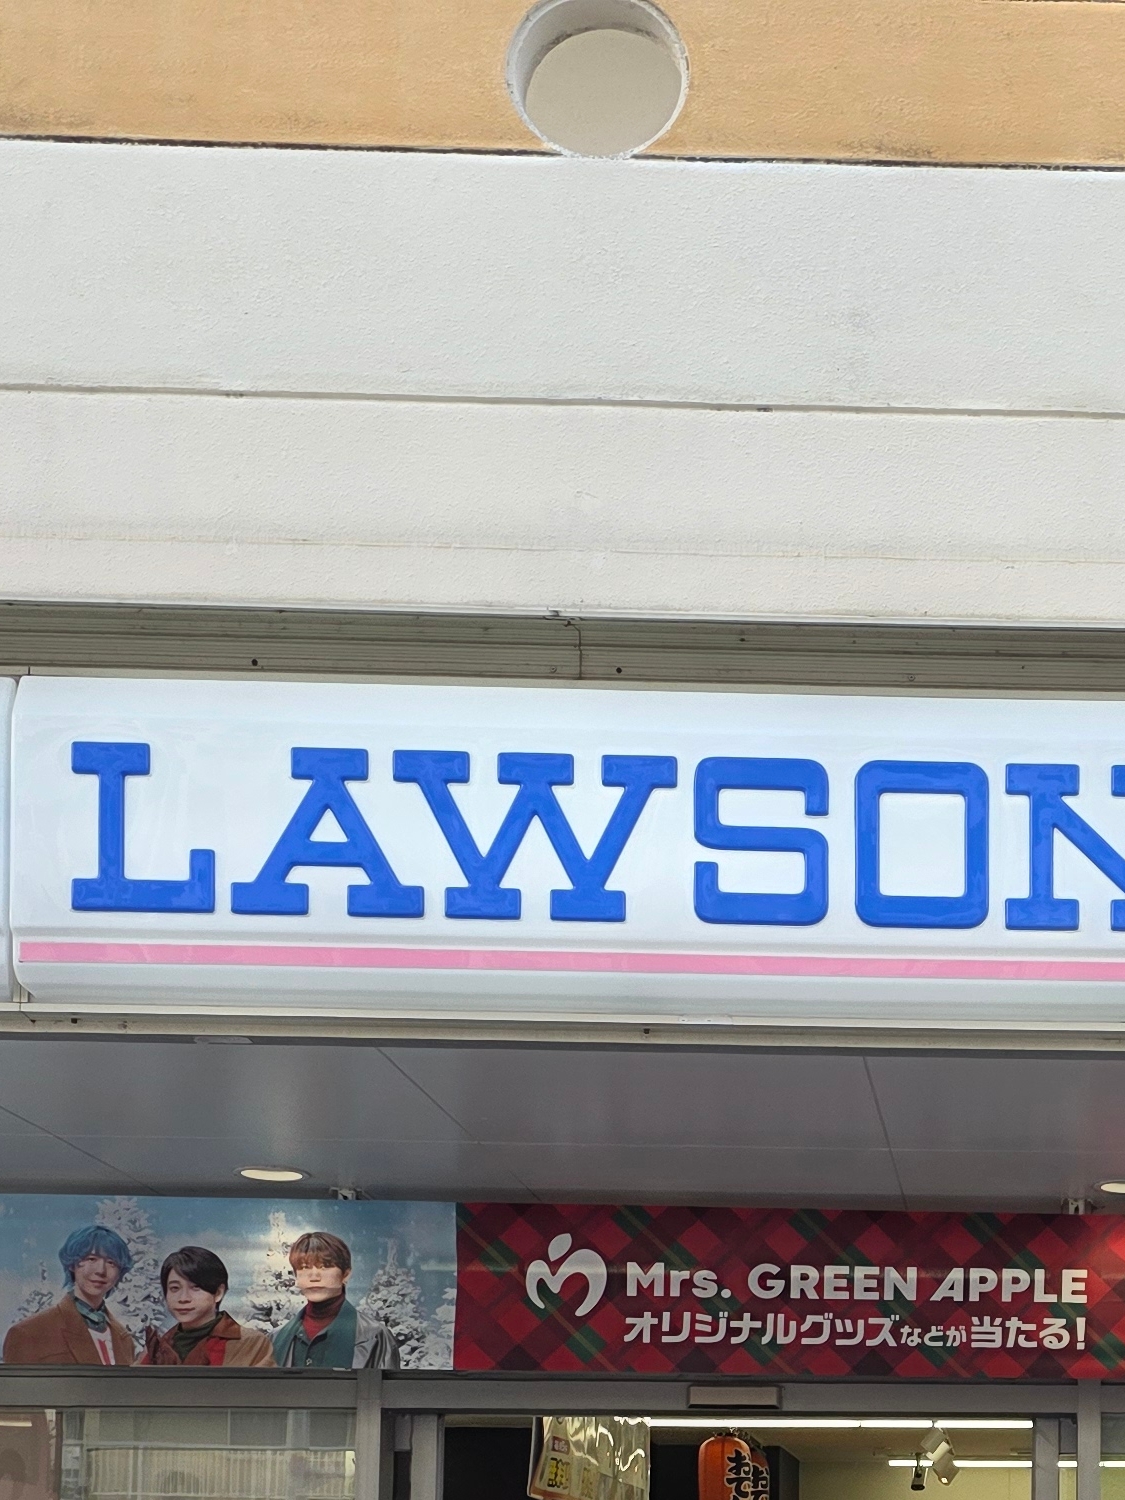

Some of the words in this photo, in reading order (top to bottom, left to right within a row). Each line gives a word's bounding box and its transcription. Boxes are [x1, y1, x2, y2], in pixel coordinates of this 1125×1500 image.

[626, 1262, 731, 1299] Mrs.
[747, 1262, 919, 1301] GREEN
[930, 1268, 1088, 1304] APPLE
[623, 1311, 1087, 1351] オリジナルグッズなどが当たる!
